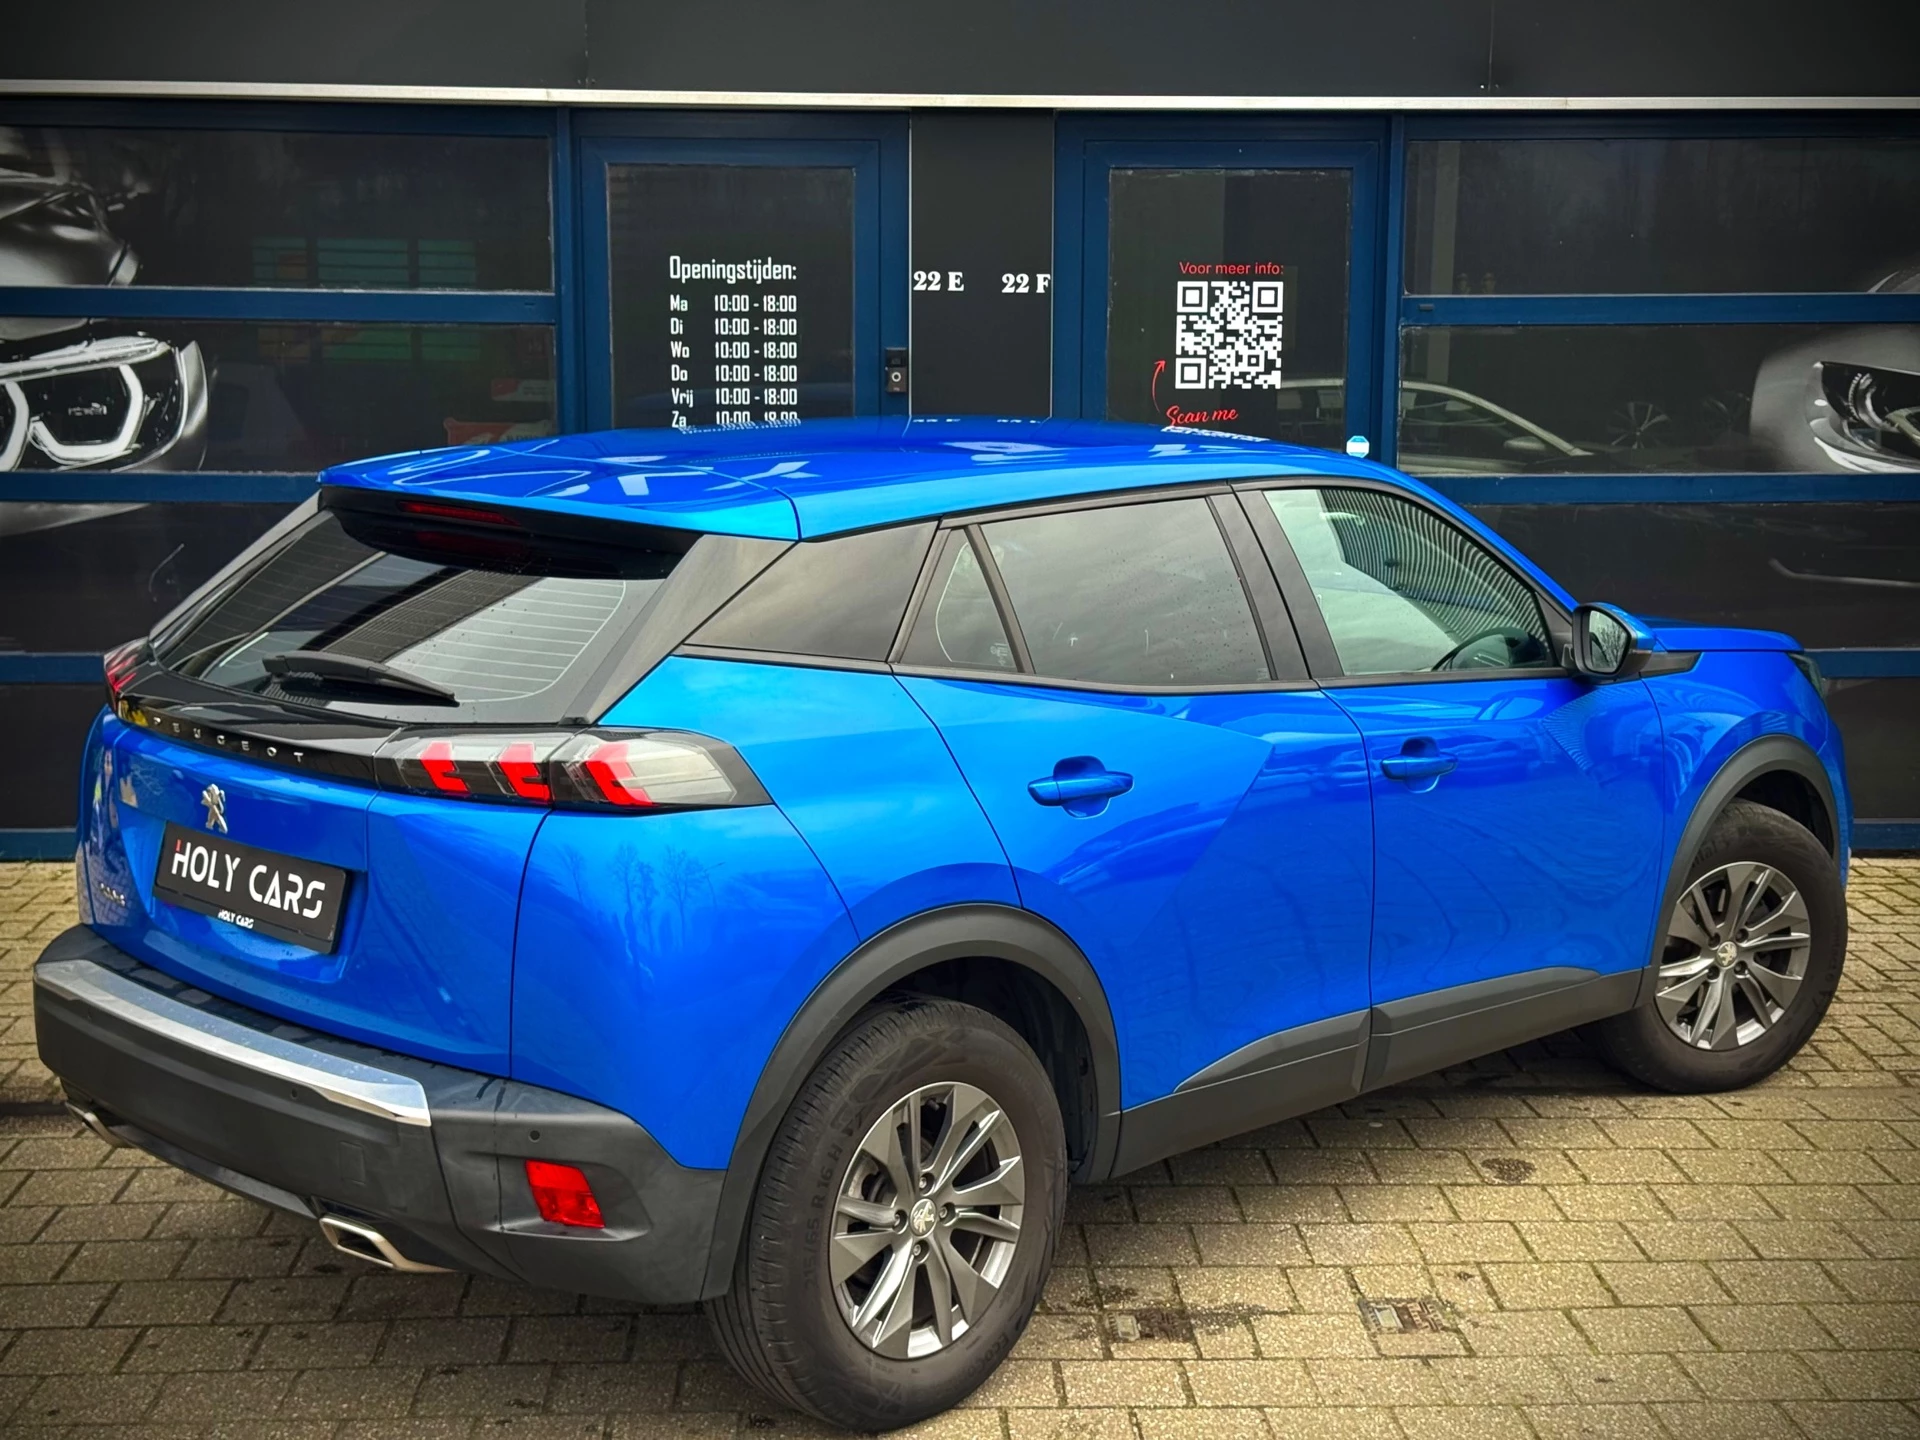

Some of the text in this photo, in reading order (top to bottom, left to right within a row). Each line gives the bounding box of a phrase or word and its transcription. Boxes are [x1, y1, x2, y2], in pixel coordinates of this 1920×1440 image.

[669, 255, 797, 284] Openingstijden:
[1179, 261, 1284, 275] Voor meer info:
[912, 270, 965, 292] 22 E
[1001, 272, 1051, 294] 22 F
[669, 295, 688, 312] Ma
[714, 295, 750, 312] 10:00
[763, 295, 798, 313] 18:00
[670, 318, 684, 335] Di
[714, 318, 750, 335] 10:00
[763, 318, 798, 336] 18:00
[671, 341, 690, 358] Wo
[714, 341, 750, 358] 10:00
[763, 341, 798, 359] 18:00
[671, 364, 688, 382] Do
[714, 364, 750, 381] 10:00
[763, 364, 798, 382] 18:00
[671, 387, 694, 408] Vrij
[714, 388, 750, 405] 10:00
[763, 388, 798, 406] 18:00
[671, 411, 687, 428] Za
[1166, 405, 1238, 427] Scan me
[153, 716, 304, 763] PEUGEOT
[171, 839, 326, 919] HOLY CARS
